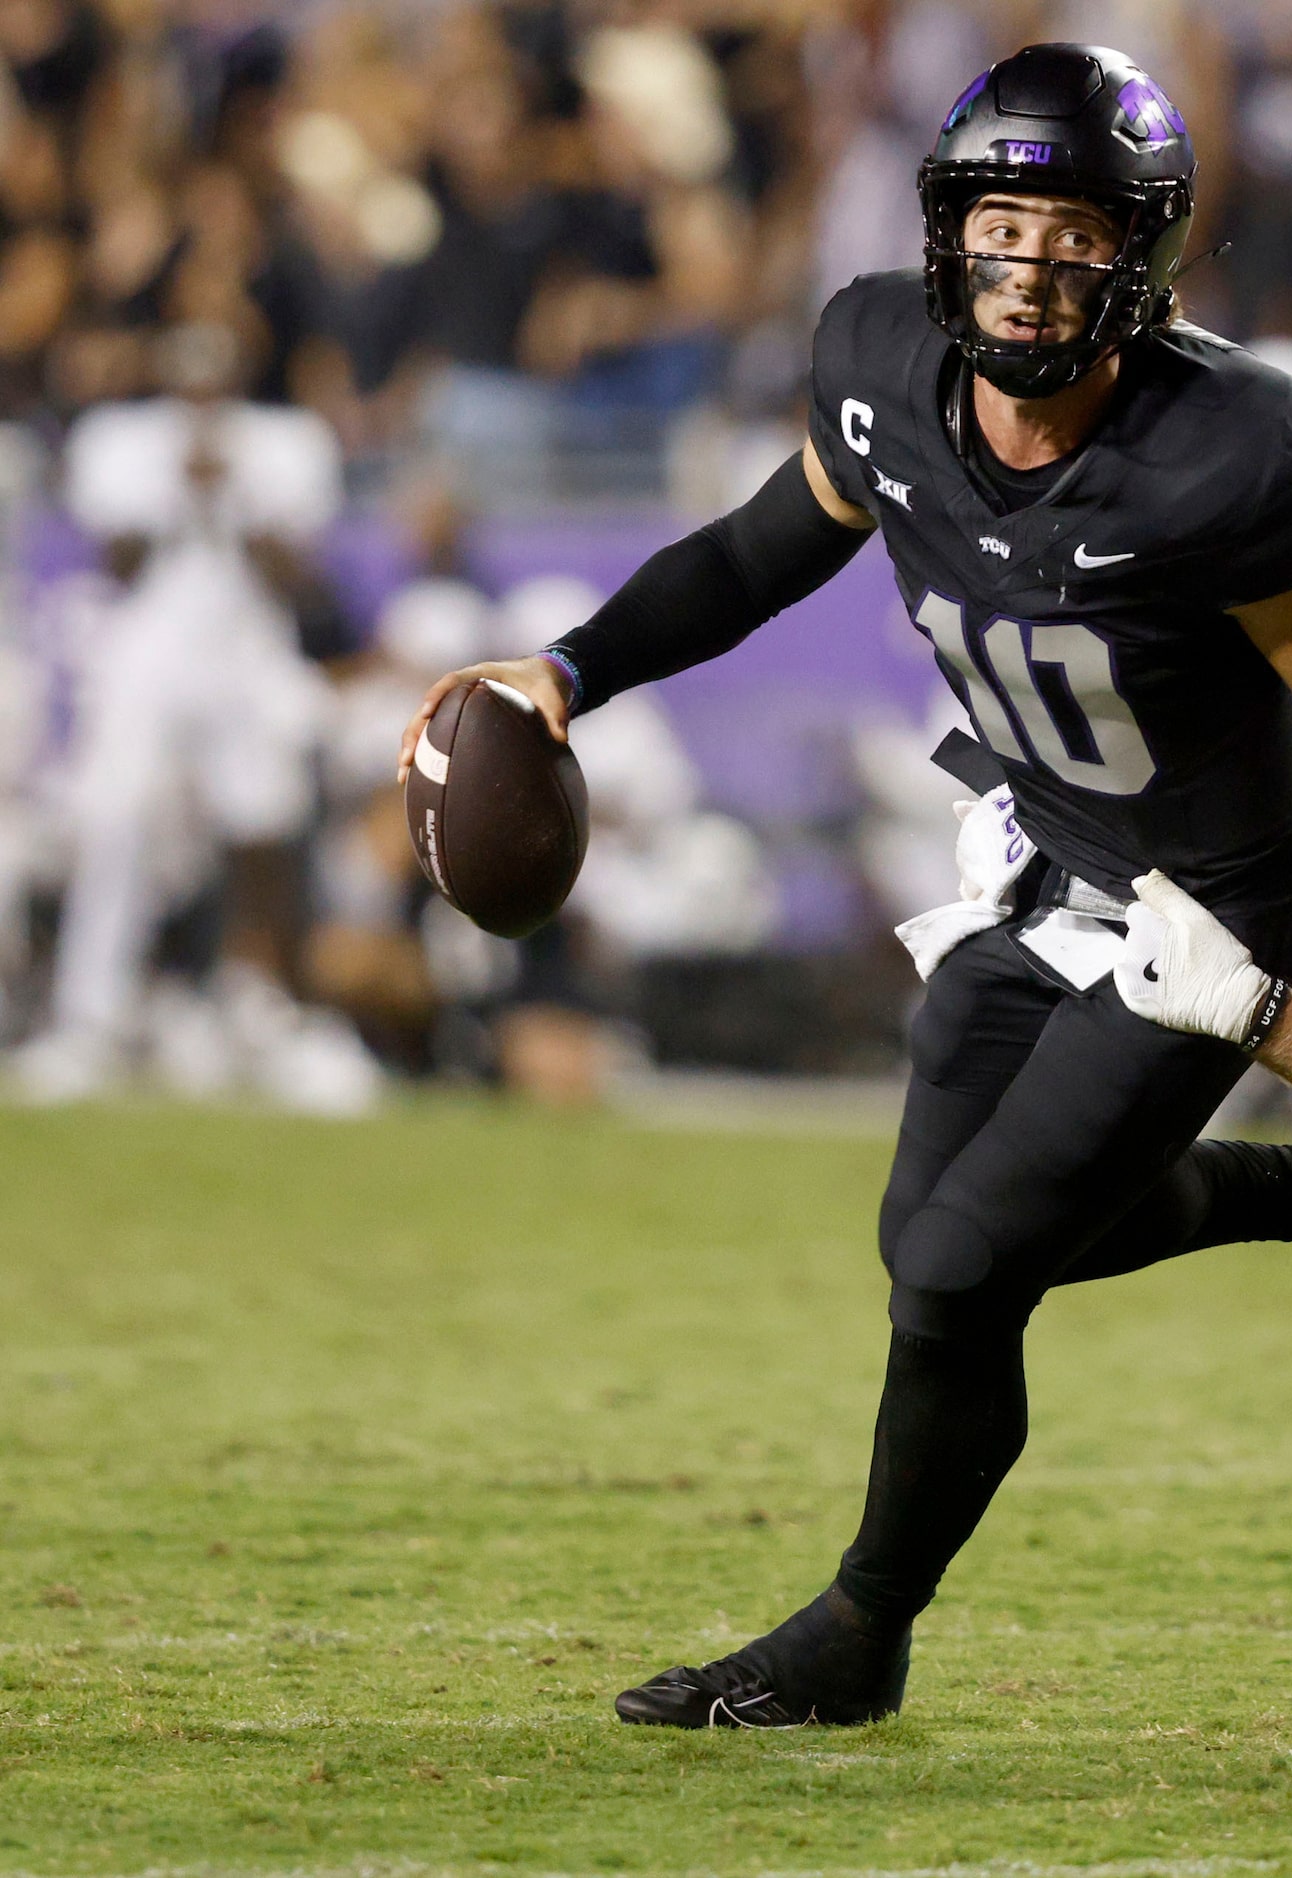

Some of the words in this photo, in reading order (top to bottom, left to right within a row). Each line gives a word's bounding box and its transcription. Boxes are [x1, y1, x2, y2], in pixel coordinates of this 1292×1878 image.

[1006, 141, 1052, 165] TCU
[841, 397, 875, 457] C
[872, 465, 913, 512] XII
[979, 536, 1011, 560] TCU
[912, 585, 1160, 798] 10
[1260, 999, 1277, 1026] UCF
